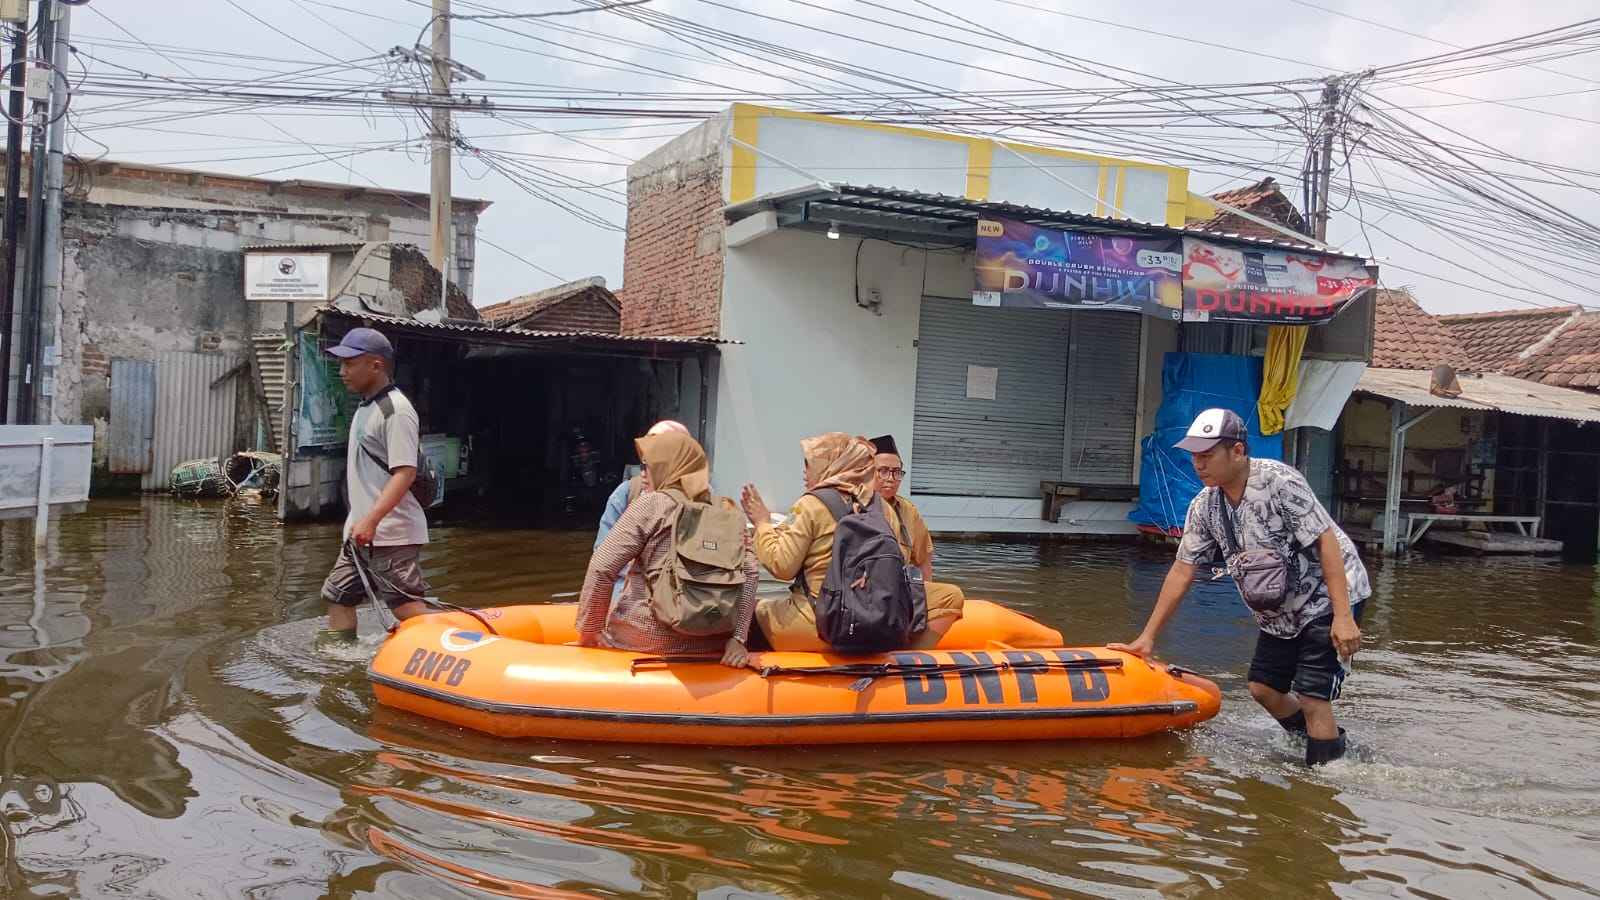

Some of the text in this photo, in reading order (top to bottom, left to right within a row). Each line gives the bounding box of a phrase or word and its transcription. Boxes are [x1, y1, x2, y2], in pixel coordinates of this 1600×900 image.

[980, 225, 1000, 233] NEW
[1028, 259, 1145, 276] DOUBLE CRUSH SENSATIONS
[1146, 255, 1162, 265] 33
[403, 648, 472, 686] BNPB
[895, 650, 1110, 705] BNPB
